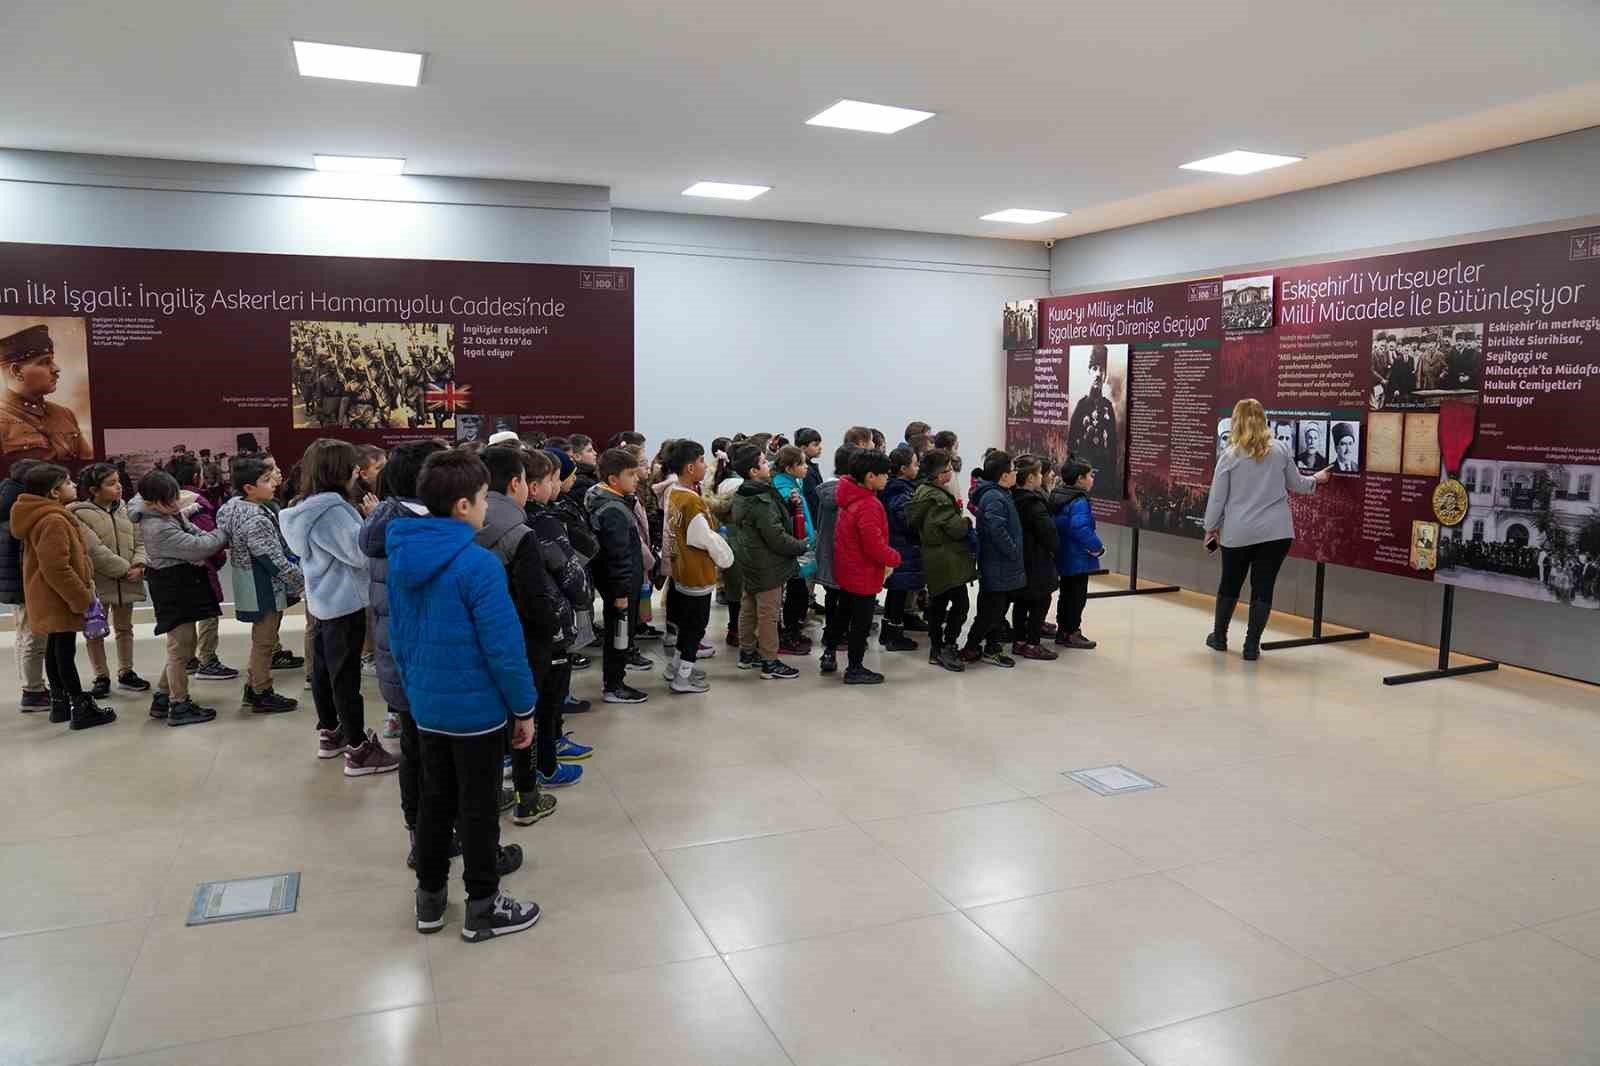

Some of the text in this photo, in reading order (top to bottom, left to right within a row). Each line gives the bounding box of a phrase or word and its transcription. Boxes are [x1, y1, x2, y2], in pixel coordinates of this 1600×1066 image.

[1281, 260, 1486, 304] Eskişehir'li Yurtseverler
[0, 279, 565, 319] n İlk İşgali: İngiliz Askerleri Hamamyolu Caddesi'nde
[1318, 297, 1404, 323] Mücadele
[1409, 290, 1433, 317] İle
[1438, 283, 1585, 315] Bütünleşiyor
[1048, 297, 1154, 323] Kuva-yı Milliye: Halk
[1048, 322, 1088, 344] İşgallere
[1089, 322, 1115, 341] Karşı
[1117, 318, 1160, 339] Direnişe
[1163, 315, 1211, 338] Geçiyor
[1488, 320, 1549, 334] Eskişehir'in
[463, 336, 532, 346] 22 Ocak 1919'da
[1487, 333, 1584, 347] birlikte Sivrihisar,
[486, 348, 514, 359] ediyor
[1486, 350, 1549, 364] Seyitgazi ve
[1485, 363, 1600, 378] Mihalıççık'ta Müdafa
[1484, 379, 1582, 393] Hukuk Cemiyetleri
[1483, 394, 1535, 407] kuruluyor
